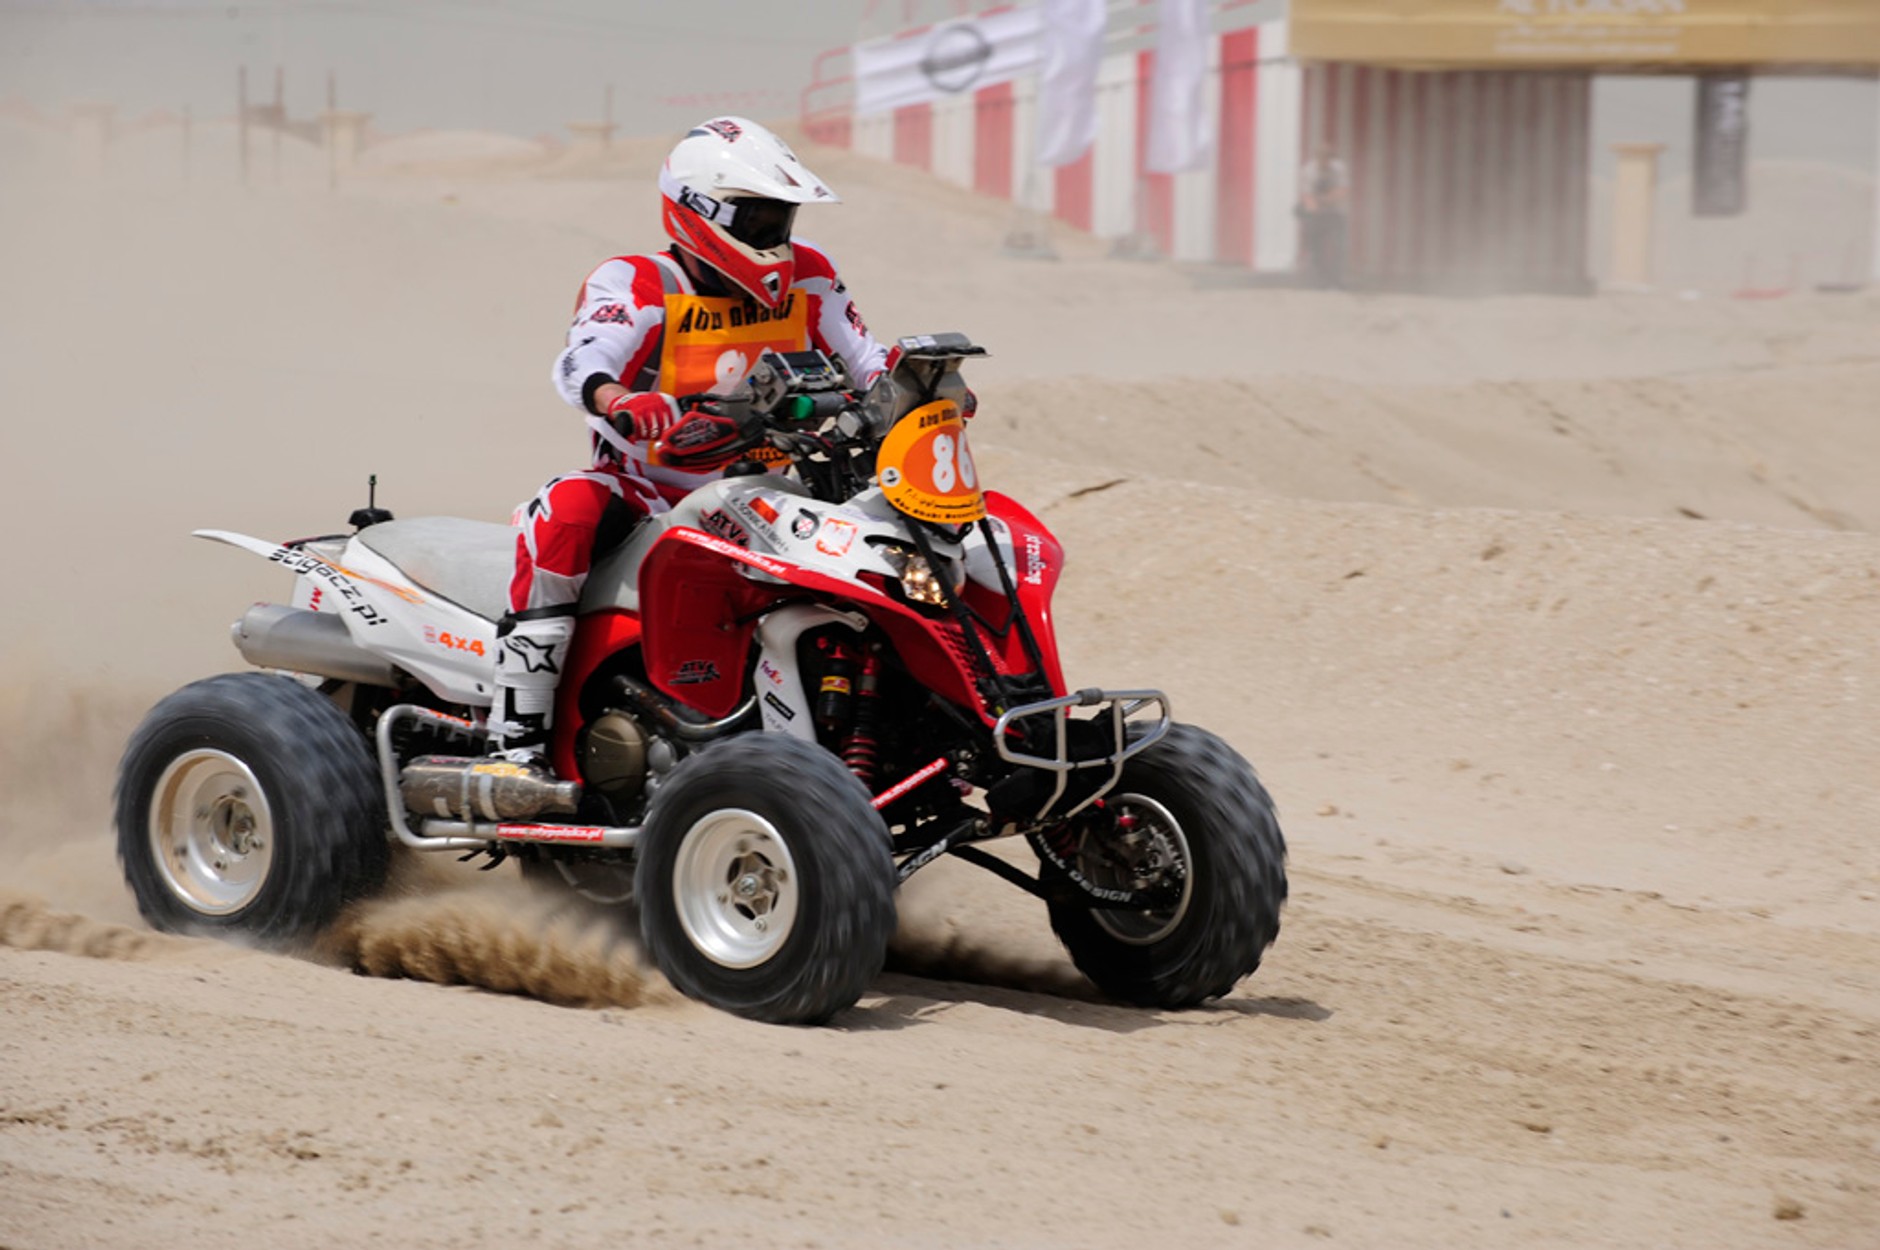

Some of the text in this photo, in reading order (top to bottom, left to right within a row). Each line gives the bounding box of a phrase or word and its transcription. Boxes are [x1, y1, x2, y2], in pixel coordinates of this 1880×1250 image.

[677, 304, 723, 333] Abu
[932, 429, 976, 493] 86
[439, 631, 486, 657] 4x4
